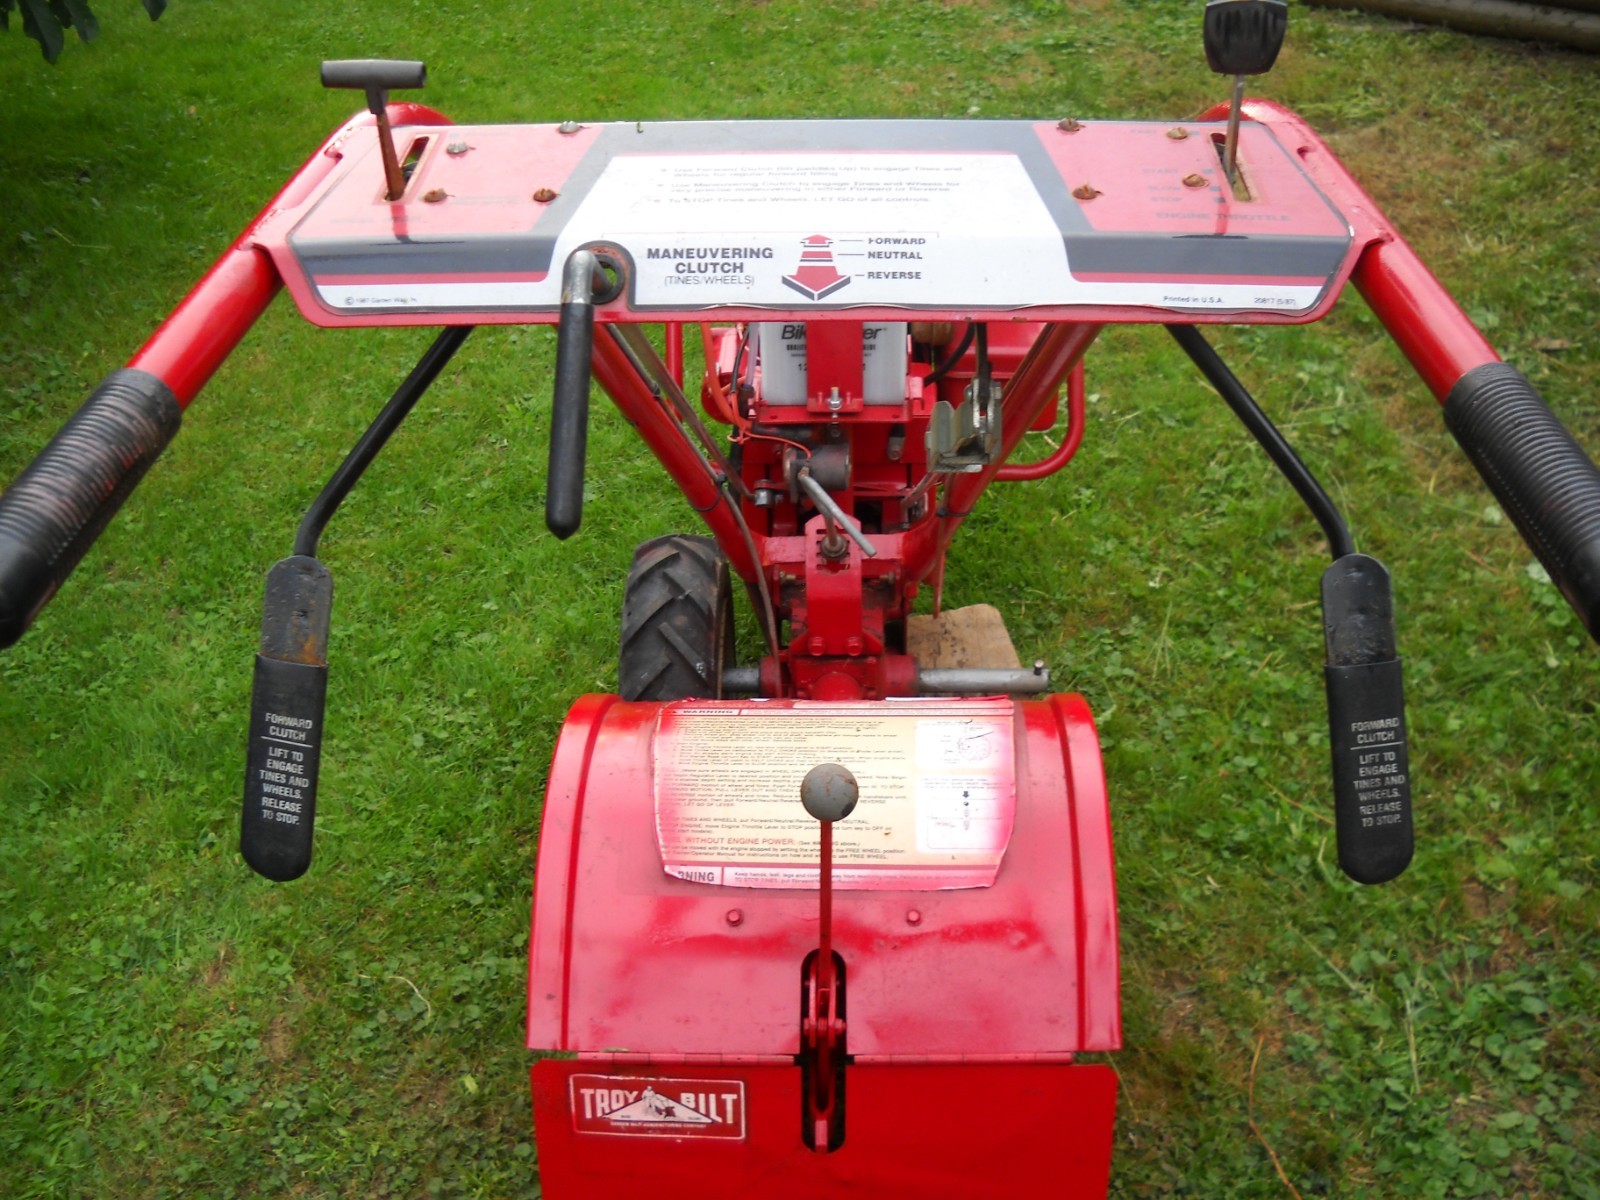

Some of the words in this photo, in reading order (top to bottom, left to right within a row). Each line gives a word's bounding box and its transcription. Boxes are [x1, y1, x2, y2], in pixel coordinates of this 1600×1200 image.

[1216, 212, 1291, 221] THROTTLE
[868, 237, 926, 245] FORWARD
[647, 247, 773, 259] MANEUVERING
[867, 251, 923, 260] NEUTRAL
[675, 262, 744, 274] CLUTCH
[664, 275, 755, 285] (TINES/WHEELS)
[867, 271, 922, 280] REVERSE
[1163, 296, 1190, 304] Printed
[265, 712, 313, 729] FORWARD
[1351, 717, 1400, 732] FORWARD
[269, 725, 306, 740] CLUTCH
[1356, 730, 1395, 744] CLUTCH
[268, 746, 289, 759] LIFT
[291, 751, 304, 762] TO
[1359, 753, 1380, 764] LIFT
[1383, 751, 1396, 762] TO
[266, 759, 304, 774] ENGAGE
[1359, 763, 1398, 777] ENGAGE
[259, 769, 287, 784] TINES
[288, 775, 310, 788] AND
[1353, 777, 1382, 790] TINES
[1384, 774, 1406, 786] AND
[262, 782, 303, 799] WHEELS.
[1358, 787, 1401, 801] WHEELS.
[261, 796, 302, 813] RELEASE
[1359, 801, 1402, 815] RELEASE
[262, 809, 274, 820] TO
[275, 811, 300, 825] STOP.
[1361, 817, 1374, 828] TO
[1376, 813, 1402, 826] STOP.
[727, 837, 760, 845] ENGINE
[579, 1088, 639, 1119] TROY
[680, 1092, 738, 1124] BILT
